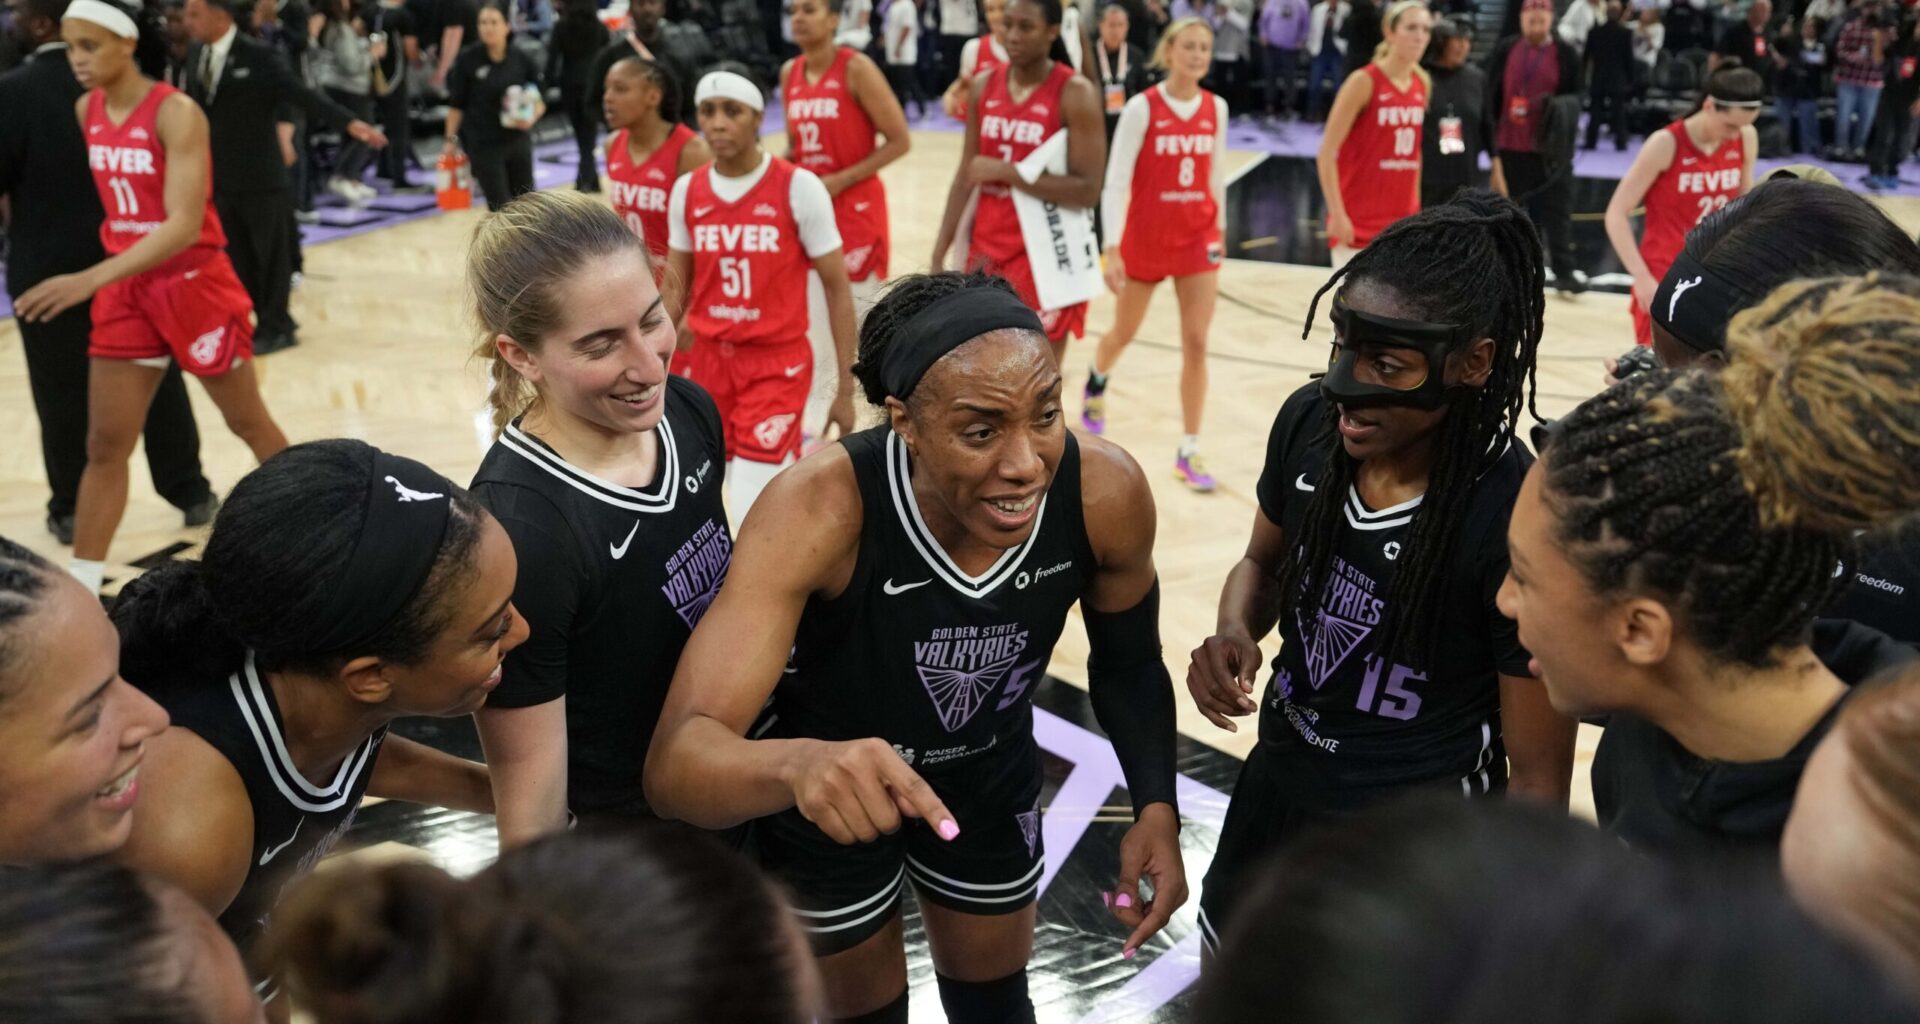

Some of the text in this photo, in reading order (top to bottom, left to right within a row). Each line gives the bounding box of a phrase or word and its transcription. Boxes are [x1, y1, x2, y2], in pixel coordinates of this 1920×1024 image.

[796, 121, 823, 152] 12
[1393, 126, 1416, 156] 10
[1178, 156, 1195, 187] 8
[109, 177, 139, 215] 11
[693, 224, 780, 252] FEVER
[719, 257, 752, 299] 51
[665, 518, 718, 576] GOLDEN STATE
[661, 524, 731, 608] VALKYRIES
[1034, 560, 1072, 584] freedom
[1346, 565, 1377, 594] STATE
[1321, 570, 1385, 626] YRIES
[1855, 572, 1905, 595] reedom
[931, 622, 1019, 640] GOLDEN STATE
[914, 630, 1029, 671] VALKYRIES
[996, 658, 1041, 711] 5
[1356, 652, 1429, 721] 15
